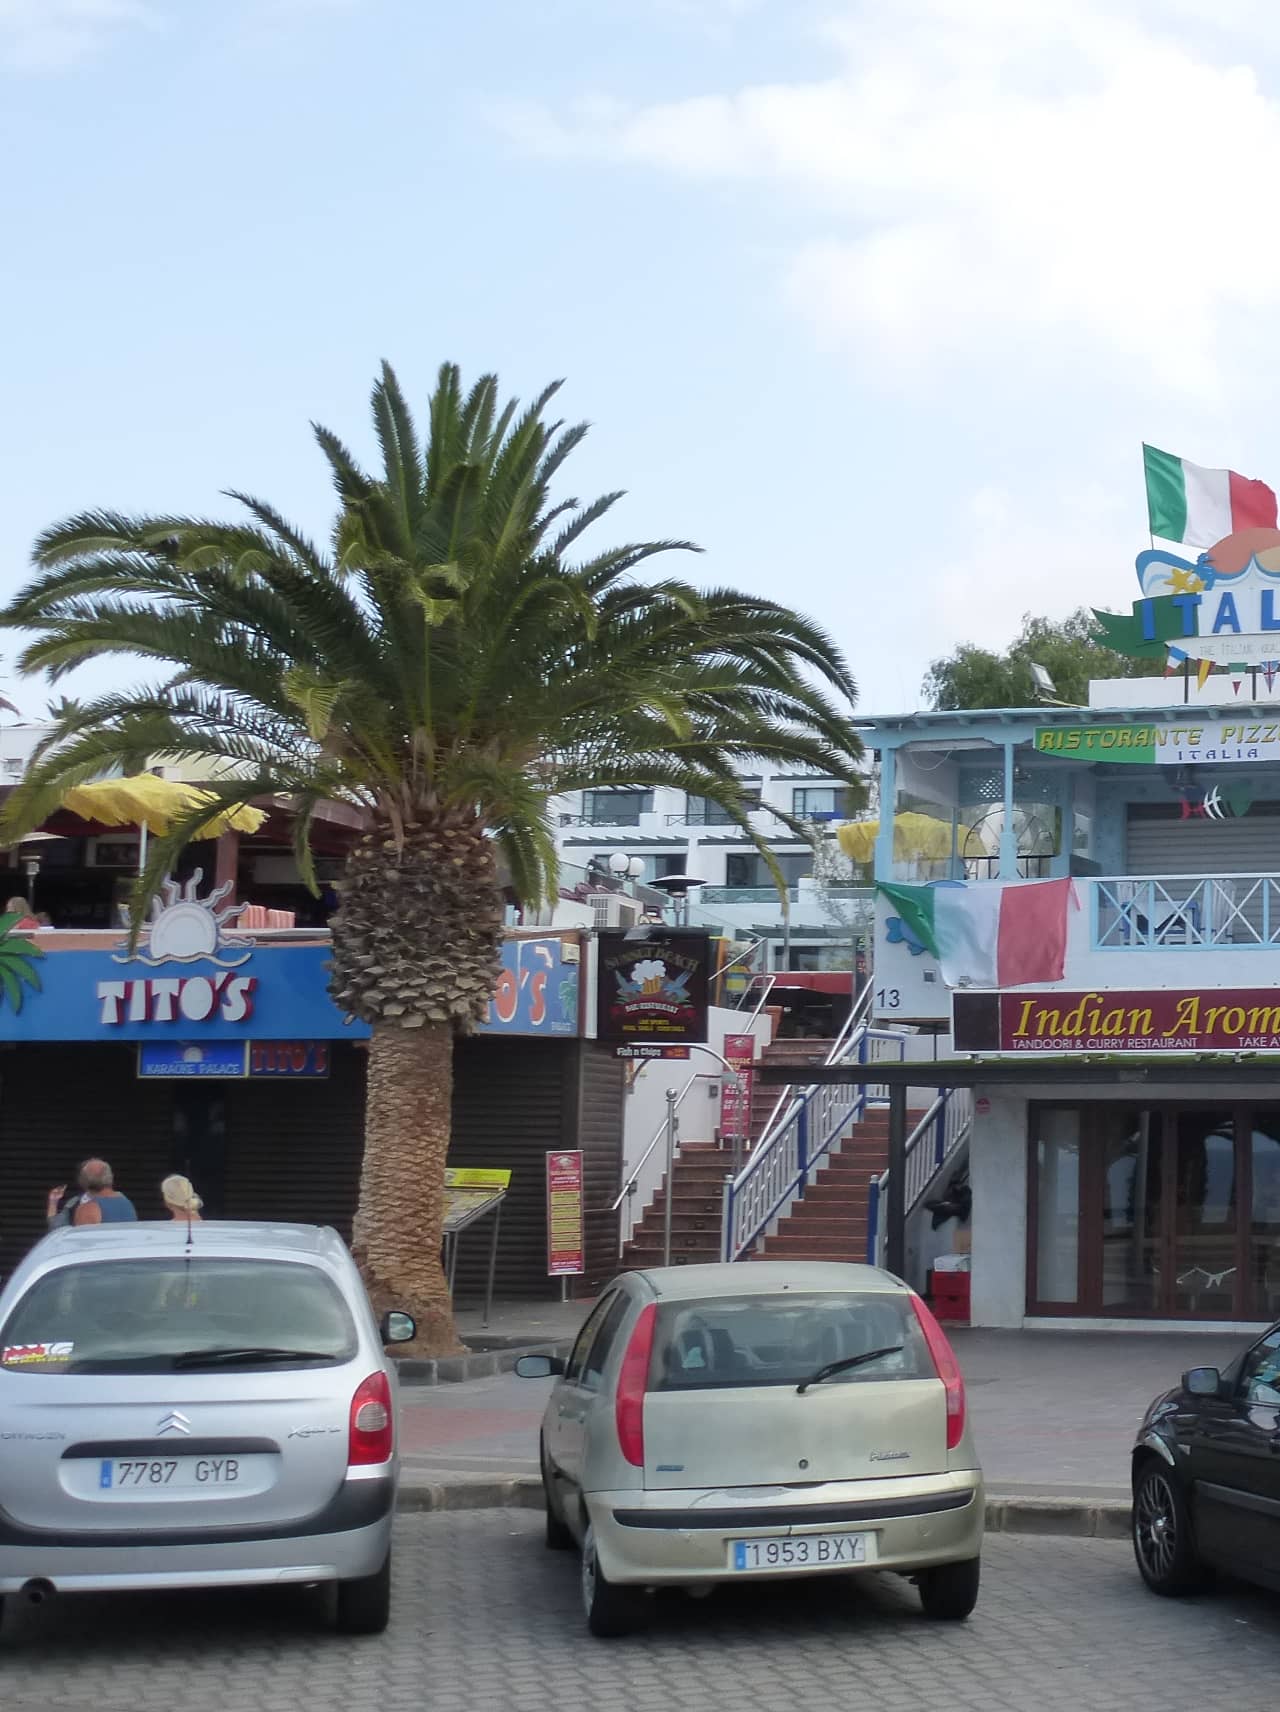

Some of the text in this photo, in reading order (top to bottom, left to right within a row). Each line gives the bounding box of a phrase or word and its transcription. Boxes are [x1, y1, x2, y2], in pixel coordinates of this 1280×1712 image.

[1039, 729, 1204, 750] RISTORANTE
[1178, 748, 1258, 760] ITALIA
[97, 972, 256, 1025] TITO'S
[876, 987, 900, 1008] 13
[1012, 992, 1154, 1037] Indian
[1012, 1037, 1198, 1049] TANDOORI & CURRY RESTAURANT
[1238, 1036, 1268, 1047] TAKE
[252, 1042, 328, 1073] TITO'S
[199, 1064, 240, 1074] PALACE
[118, 1459, 240, 1485] 7787 GYB
[752, 1537, 860, 1567] 1953 BXY
